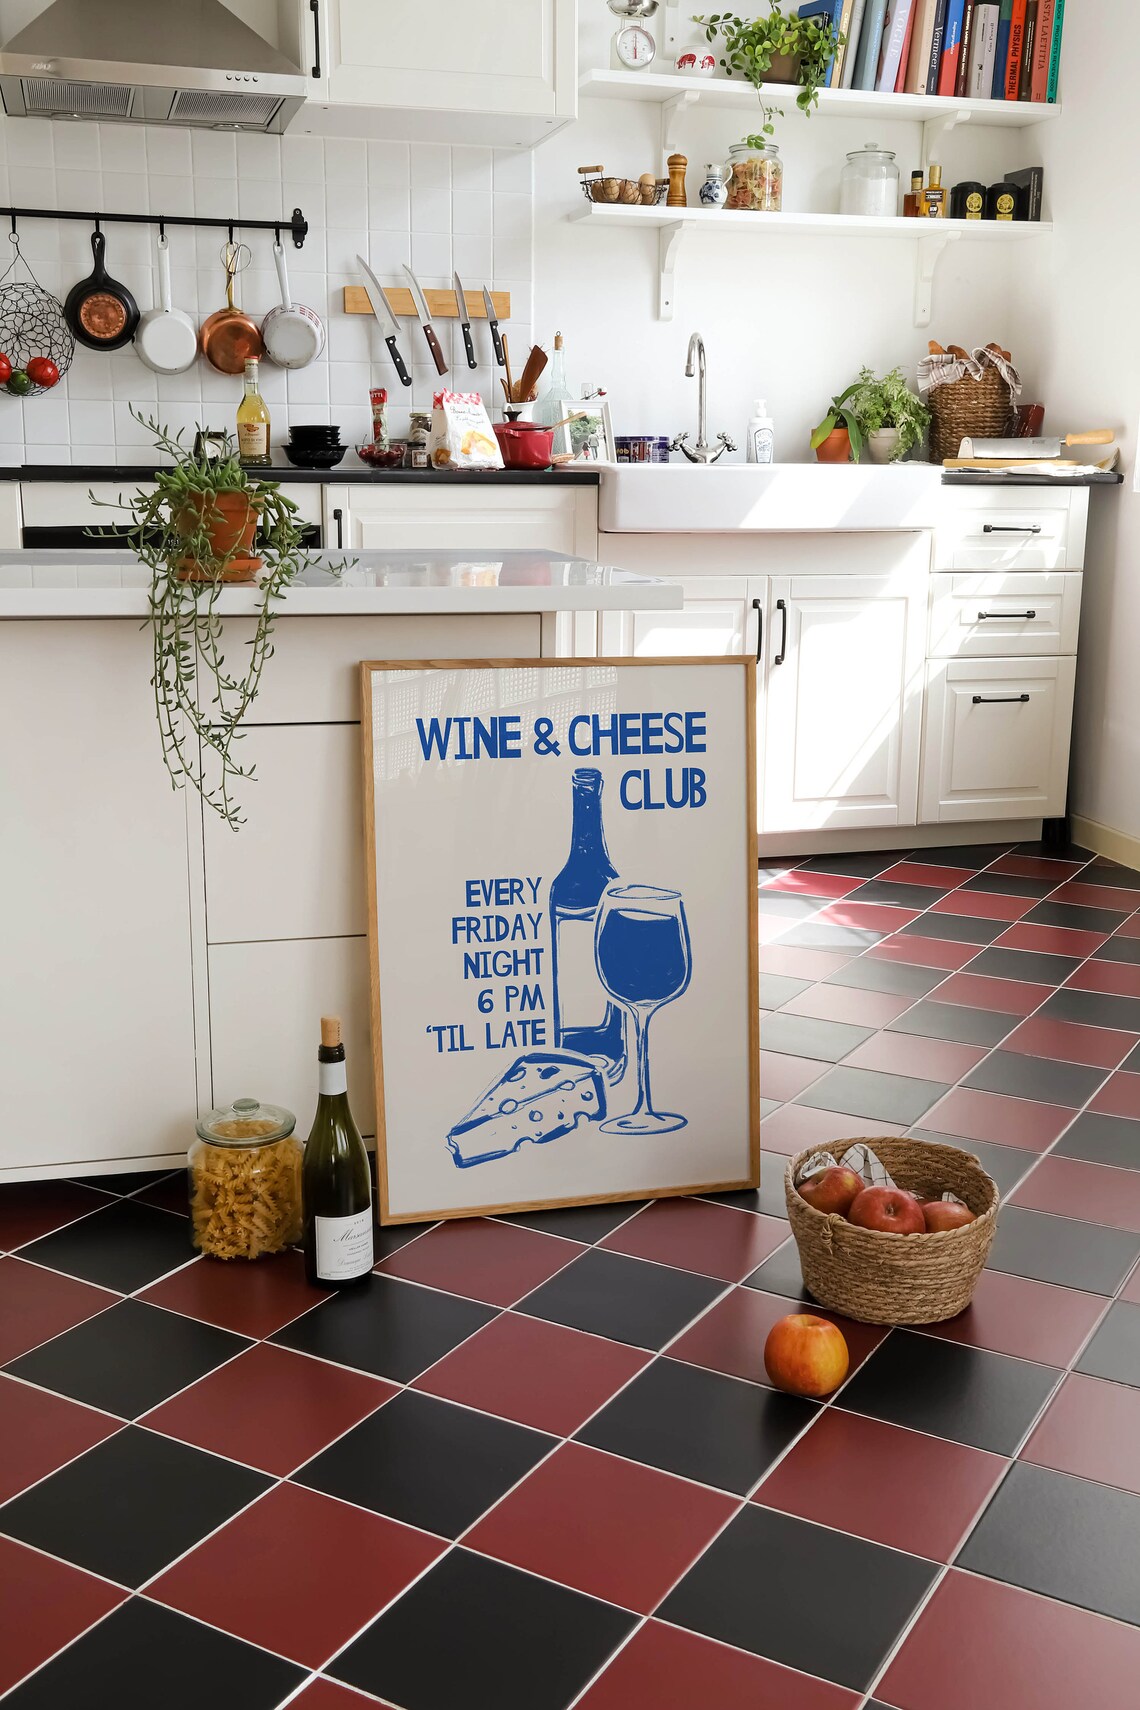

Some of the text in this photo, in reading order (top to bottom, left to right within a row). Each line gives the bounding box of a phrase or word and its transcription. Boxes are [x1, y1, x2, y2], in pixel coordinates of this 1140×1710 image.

[890, 9, 907, 58] VOGUE
[931, 26, 943, 70] Vermeer
[1038, 26, 1049, 70] LAETITIA
[1008, 24, 1022, 95] THERMAL PHYSICS
[416, 712, 706, 760] WINE & CHEESE
[620, 768, 706, 810] CLUB
[466, 878, 541, 907] EVERY
[452, 913, 542, 944] FRIDAY
[464, 948, 544, 978] NIGHT
[478, 984, 544, 1014] 6 PM
[486, 1019, 546, 1048] LATE
